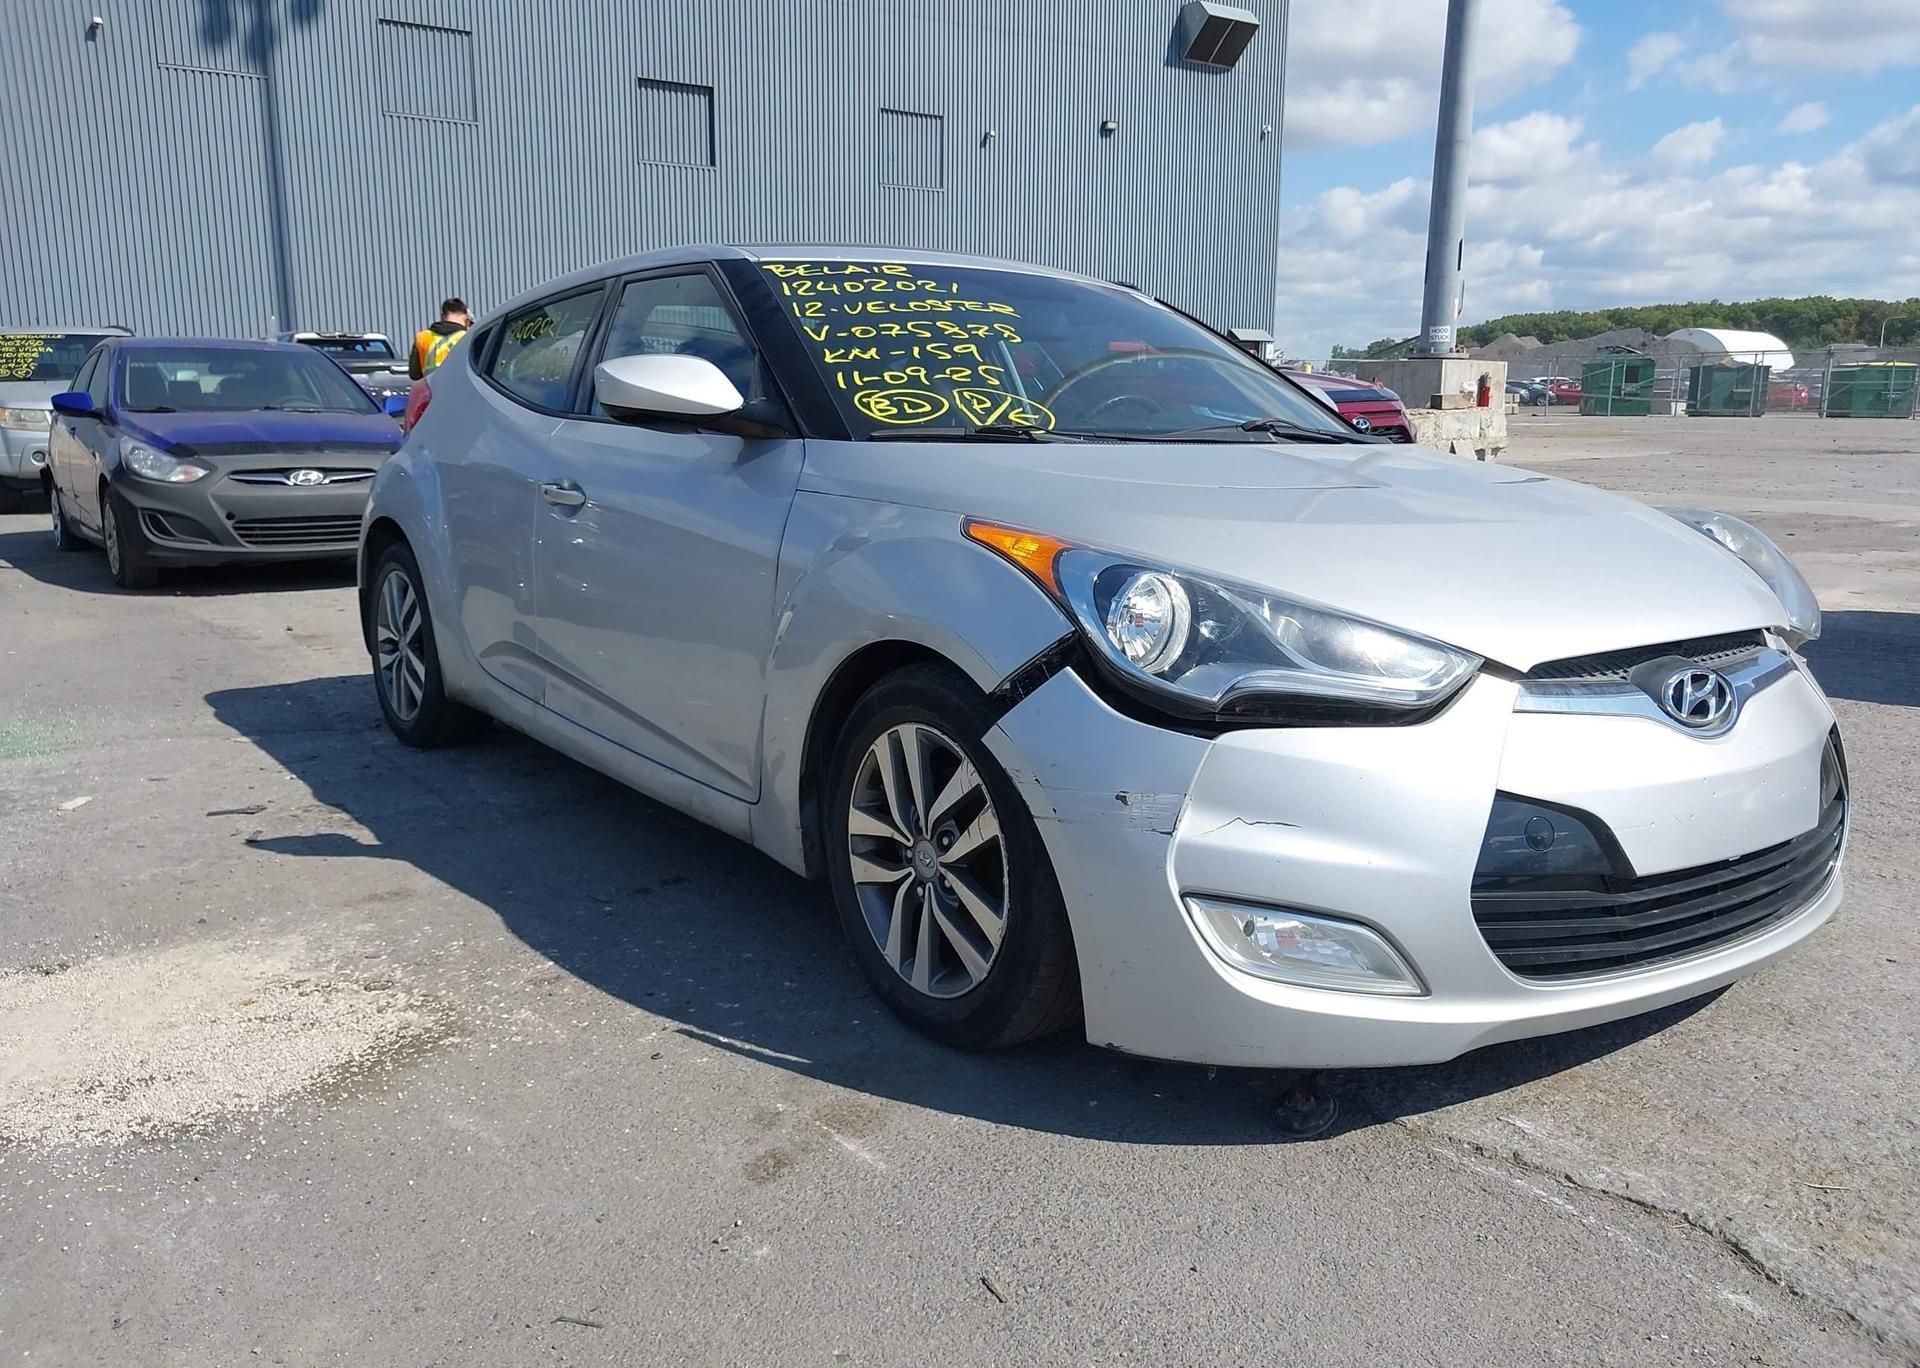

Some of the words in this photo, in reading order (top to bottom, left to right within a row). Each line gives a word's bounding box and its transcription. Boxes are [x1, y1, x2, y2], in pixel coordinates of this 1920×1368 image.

[762, 264, 912, 277] BELAIR
[781, 278, 959, 296] 12402021
[792, 299, 1022, 318] 12-VELOSTER
[803, 320, 1022, 343] V-075878
[823, 343, 983, 364] KM-159
[836, 366, 1005, 389] 11-09-25
